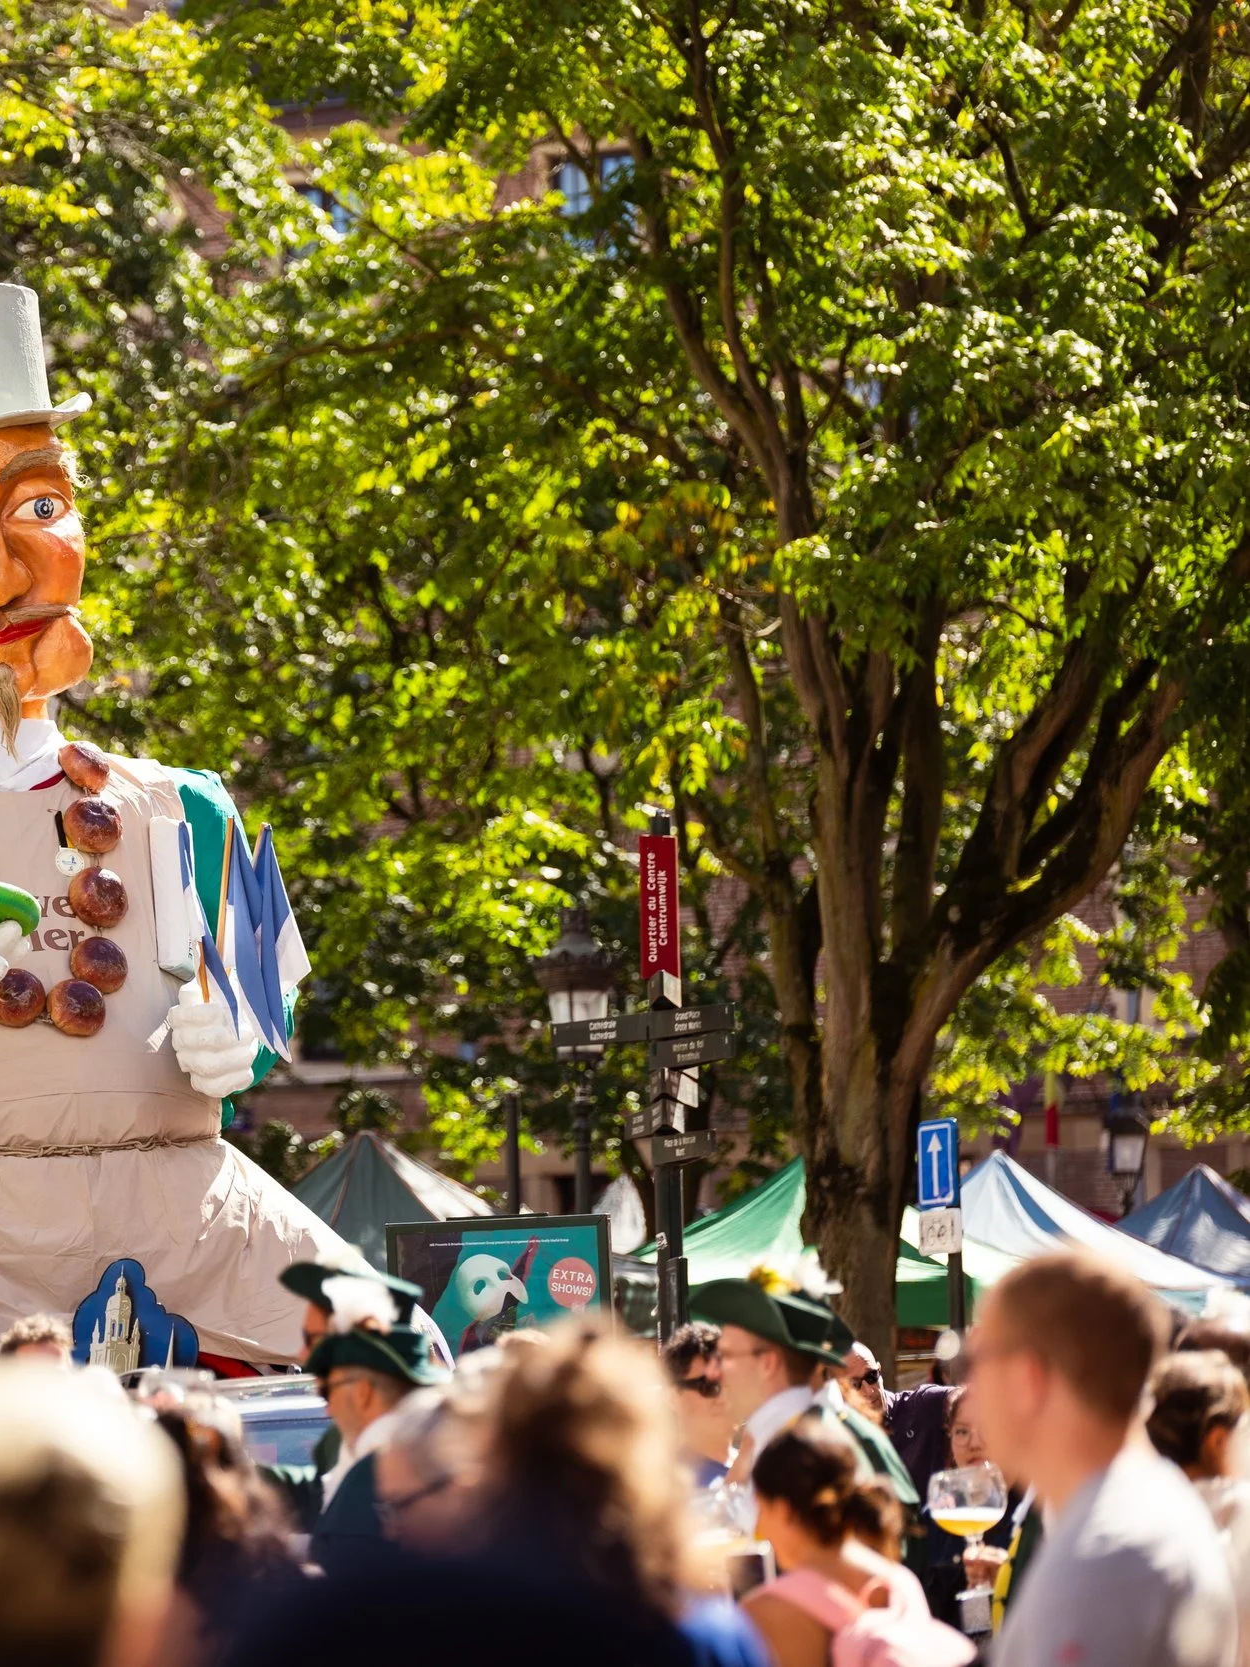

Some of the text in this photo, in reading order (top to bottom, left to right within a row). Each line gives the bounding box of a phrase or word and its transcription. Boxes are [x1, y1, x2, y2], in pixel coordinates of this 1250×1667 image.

[646, 852, 658, 963] Quartier du Centre
[656, 869, 668, 946] Centrumwijk
[551, 1282, 592, 1297] SHOWS!
[552, 1269, 594, 1284] EXTRA
